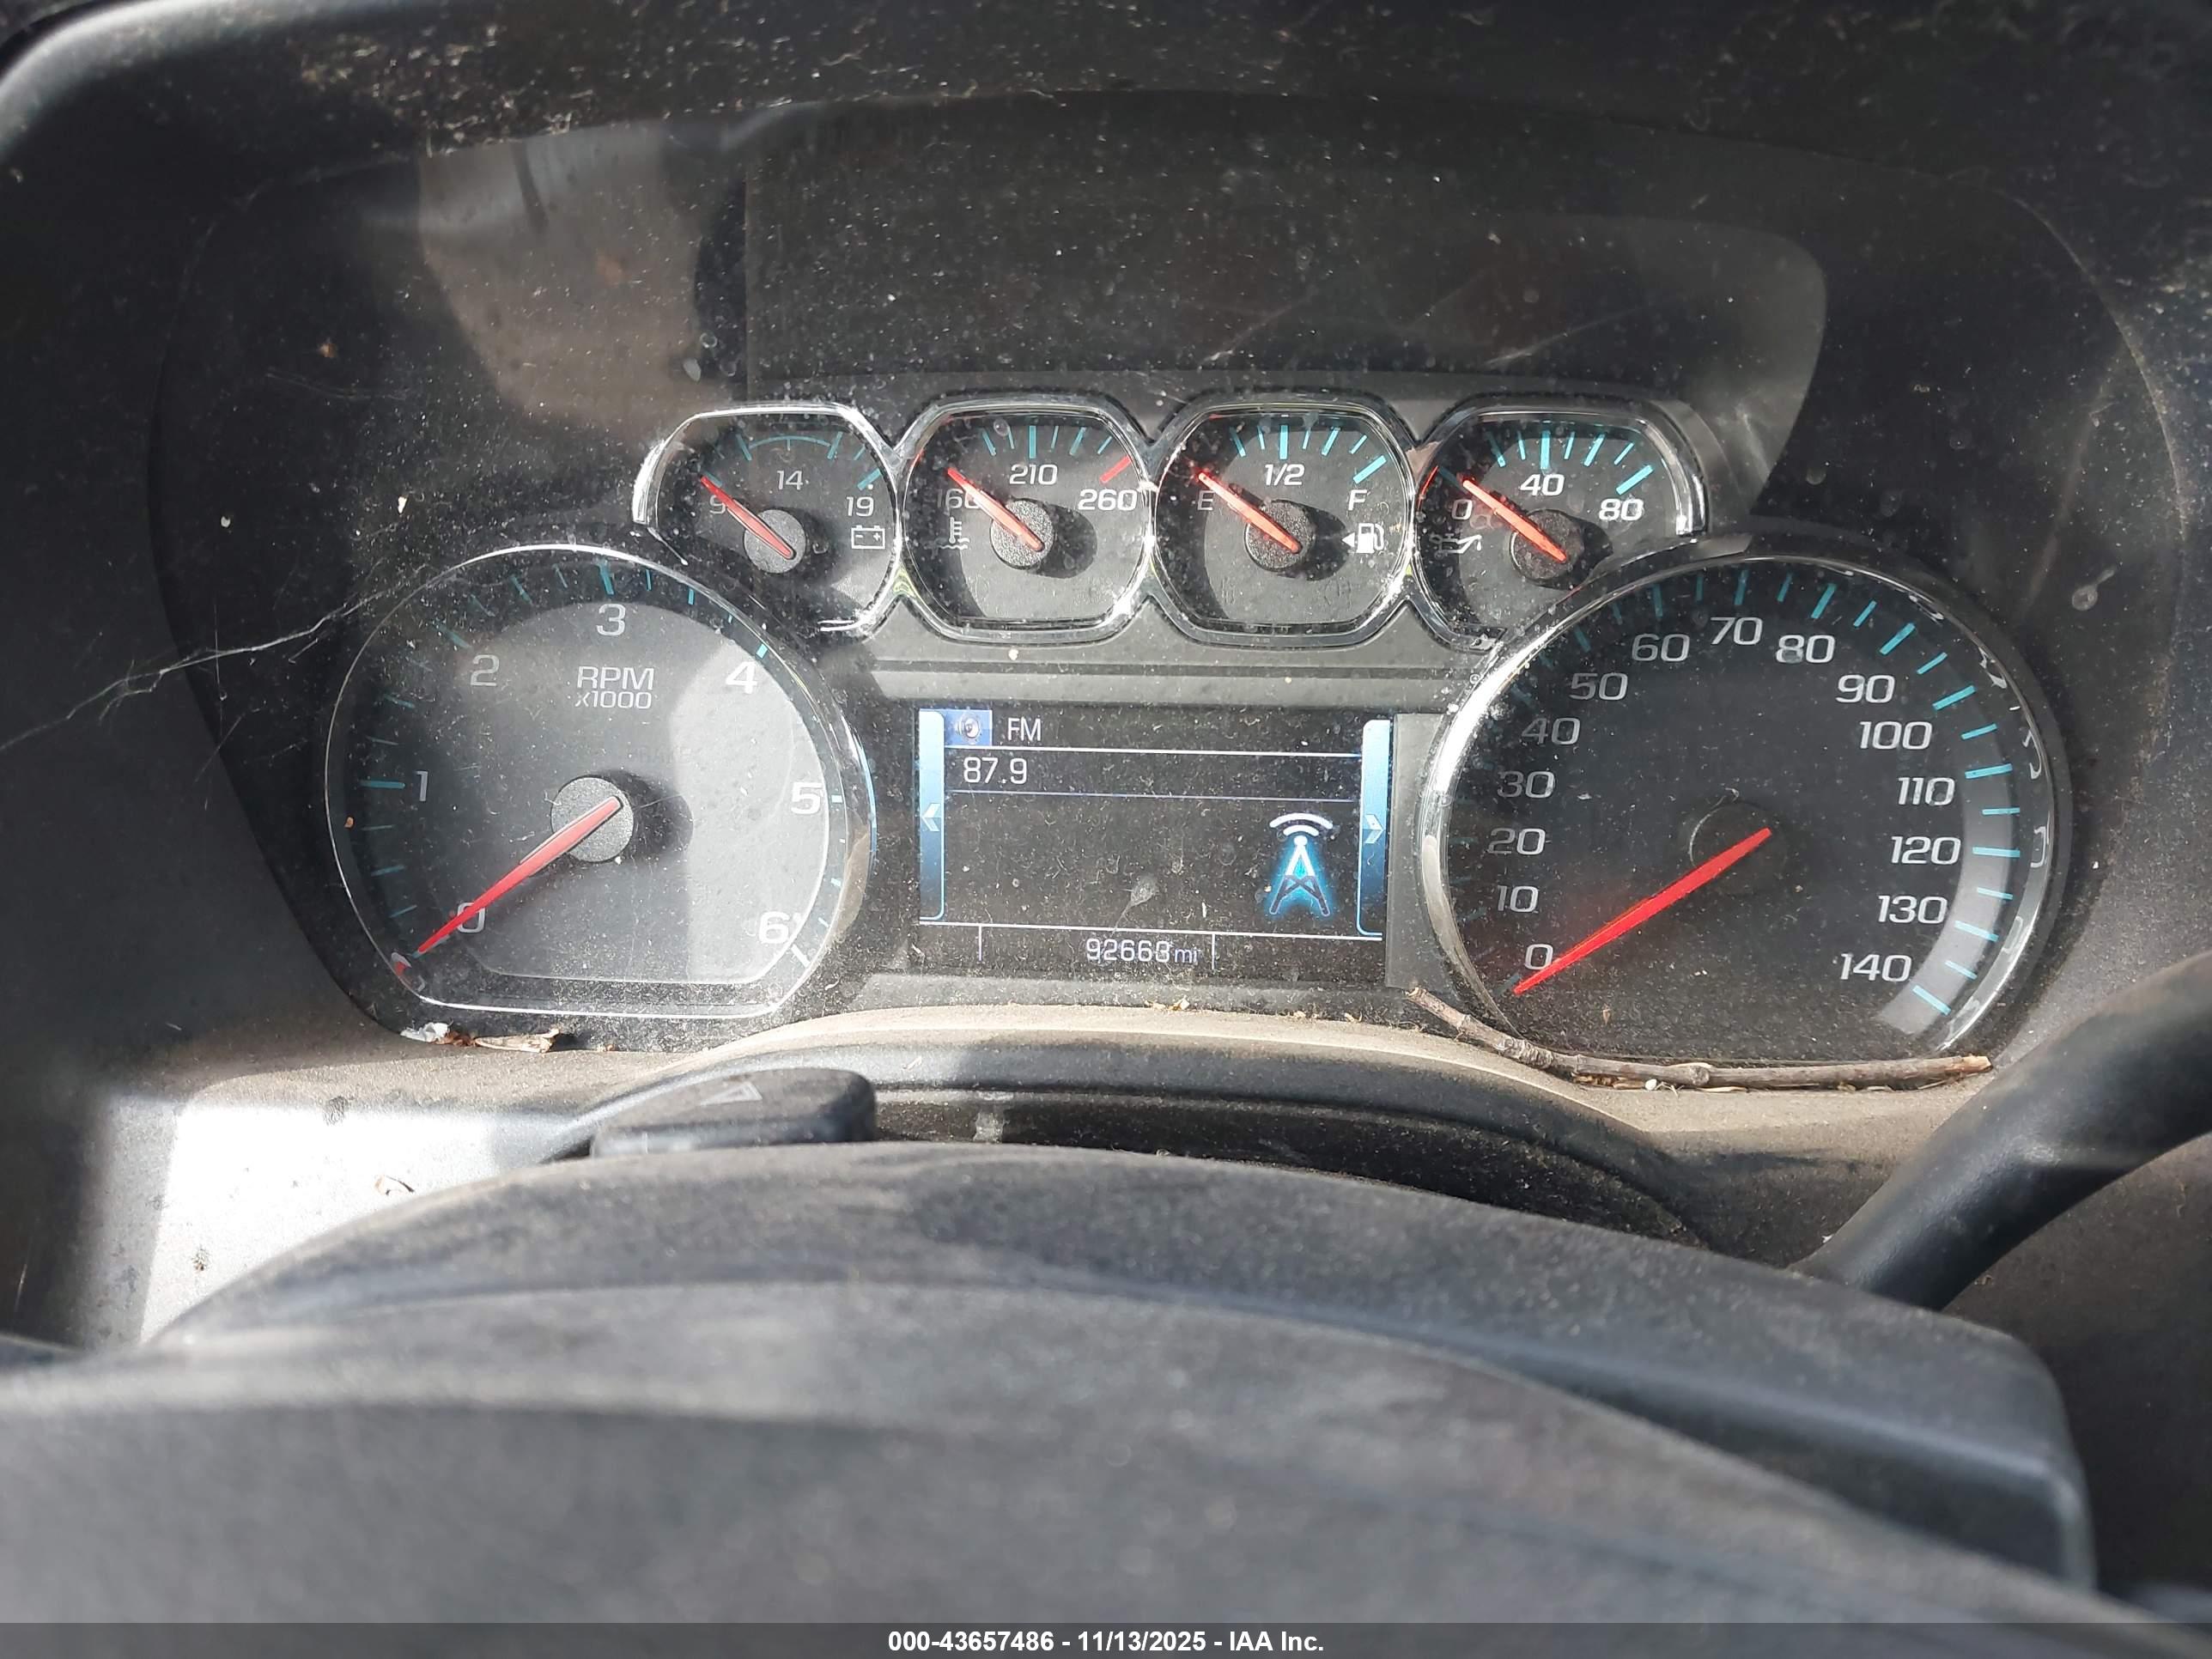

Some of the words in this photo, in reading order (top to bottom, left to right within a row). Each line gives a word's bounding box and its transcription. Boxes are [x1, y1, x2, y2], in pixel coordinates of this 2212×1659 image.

[776, 469, 804, 490] 14
[1009, 464, 1058, 486] 210
[1264, 463, 1304, 486] 1/2
[1520, 472, 1565, 496] 40
[846, 495, 874, 517] 19
[1078, 489, 1136, 512] 260
[1198, 489, 1214, 512] E
[1348, 489, 1367, 511] F
[1451, 499, 1472, 520] 0
[1598, 500, 1644, 521] 80
[596, 604, 627, 636] 3
[1711, 617, 1763, 646] 70
[1632, 634, 1690, 663] 60
[1776, 634, 1836, 664] 80
[470, 654, 500, 687] 2
[576, 665, 654, 690] RPM
[726, 660, 758, 695] 4
[1570, 672, 1629, 701] 50
[1836, 675, 1896, 703] 90
[1007, 718, 1042, 740] FM
[1522, 718, 1581, 745] 40
[1858, 721, 1933, 750] 100
[963, 757, 1028, 785] 87.9
[1497, 770, 1555, 799] 30
[416, 770, 429, 801] 1
[791, 781, 823, 815] 5
[1897, 776, 1954, 806] 110
[1488, 828, 1546, 856] 20
[1891, 836, 1961, 865] 120
[1498, 885, 1539, 913] 10
[1877, 895, 1948, 923] 130
[456, 902, 487, 933] 0
[757, 912, 791, 944] 6
[1524, 944, 1553, 969] 0
[1839, 952, 1911, 981] 140
